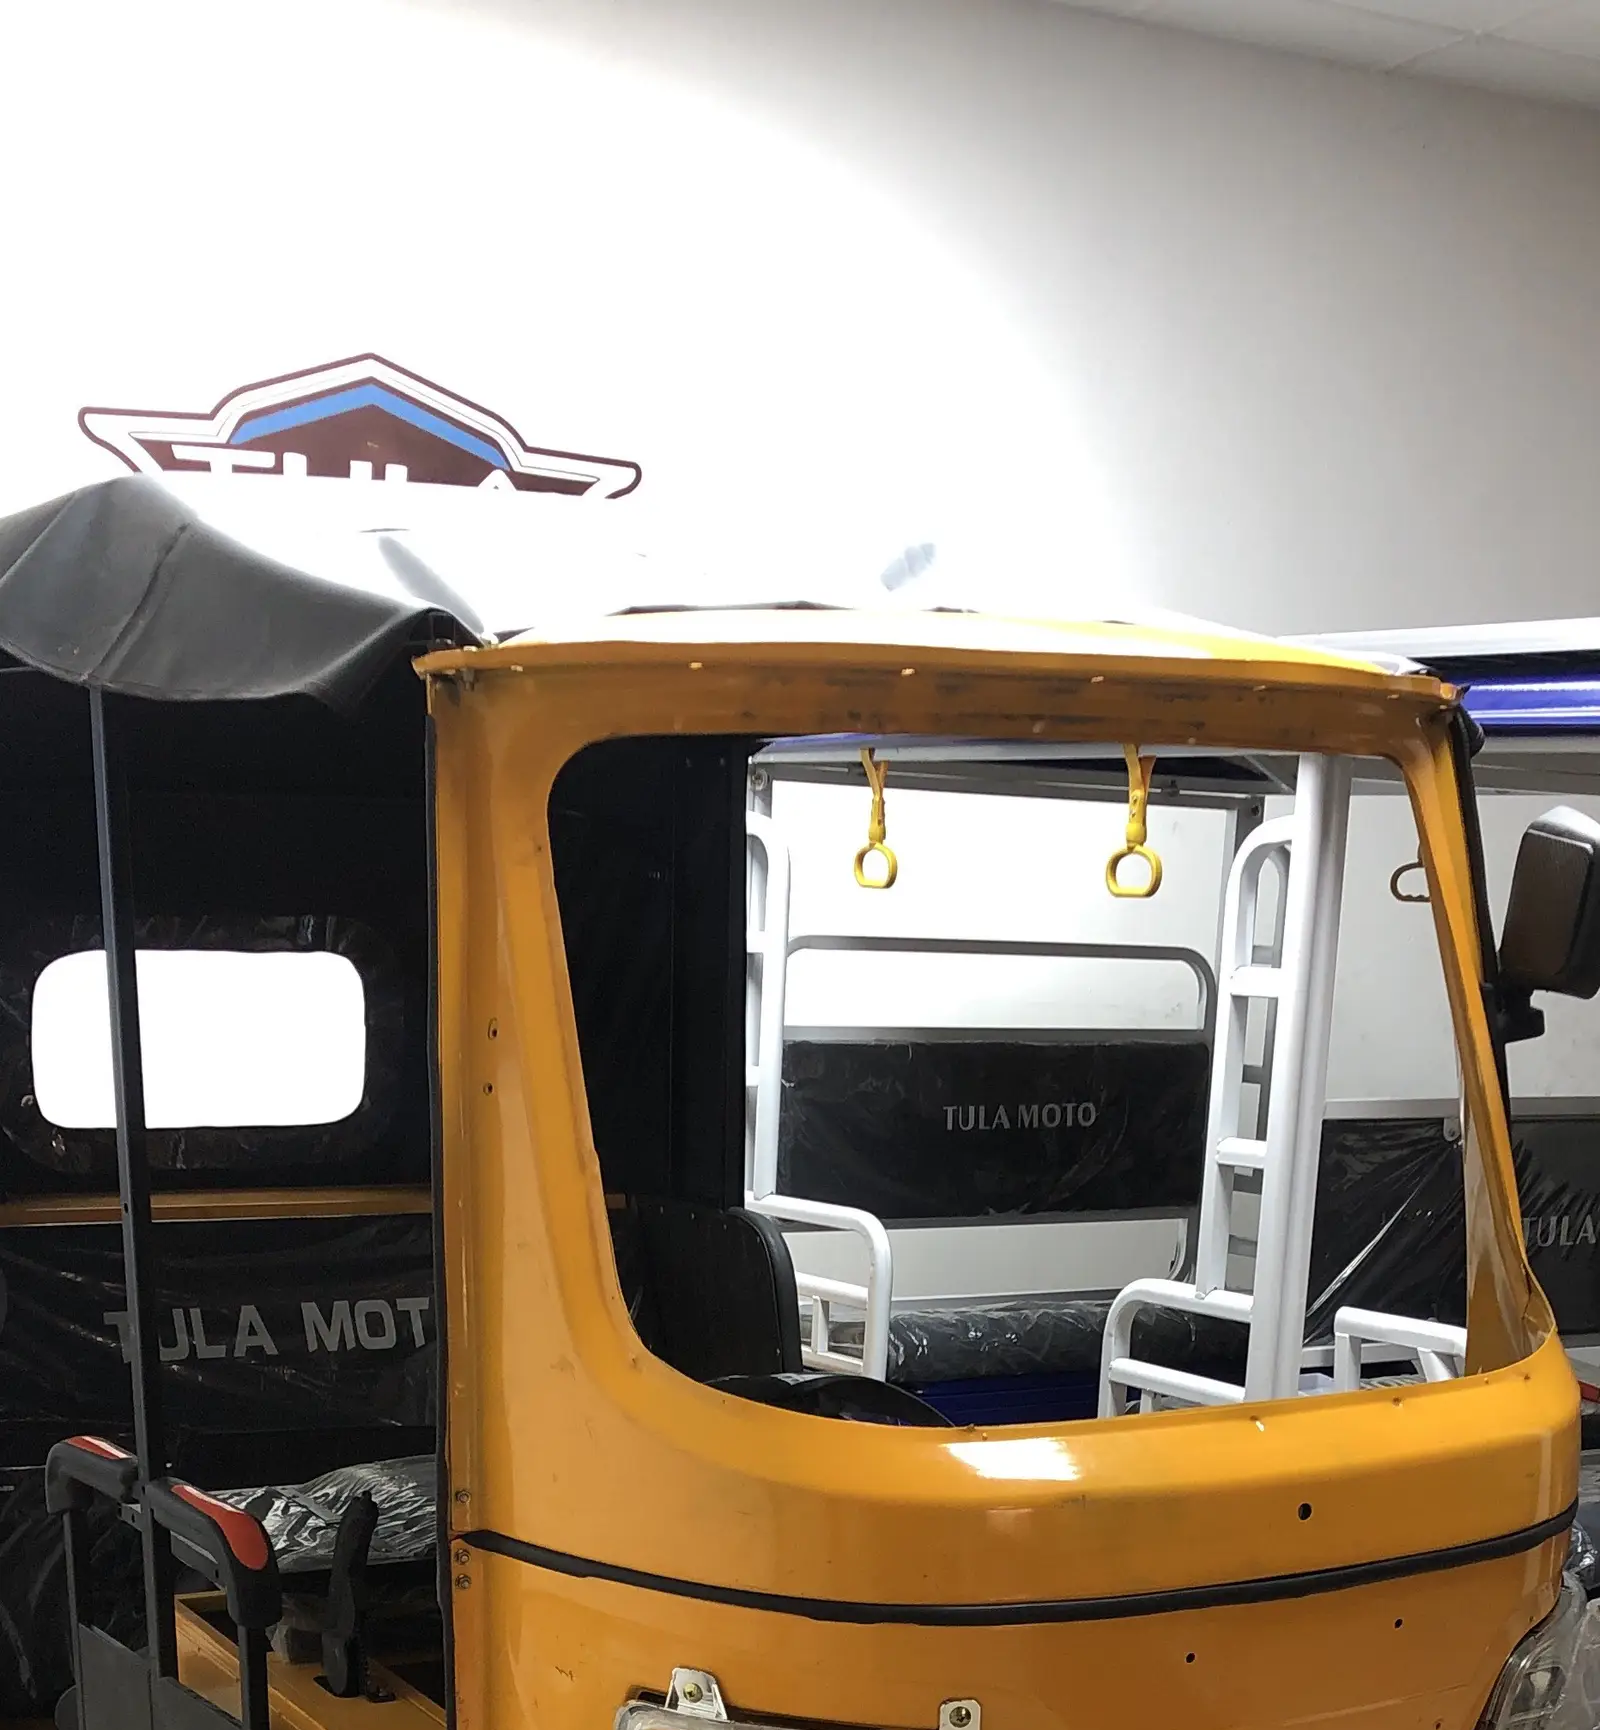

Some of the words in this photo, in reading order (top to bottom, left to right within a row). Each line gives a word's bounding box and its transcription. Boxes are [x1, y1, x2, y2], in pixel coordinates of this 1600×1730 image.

[942, 1104, 1010, 1131] TULA
[1017, 1102, 1097, 1128] MOTO
[1523, 1214, 1597, 1248] TULA
[301, 1297, 430, 1353] MOT
